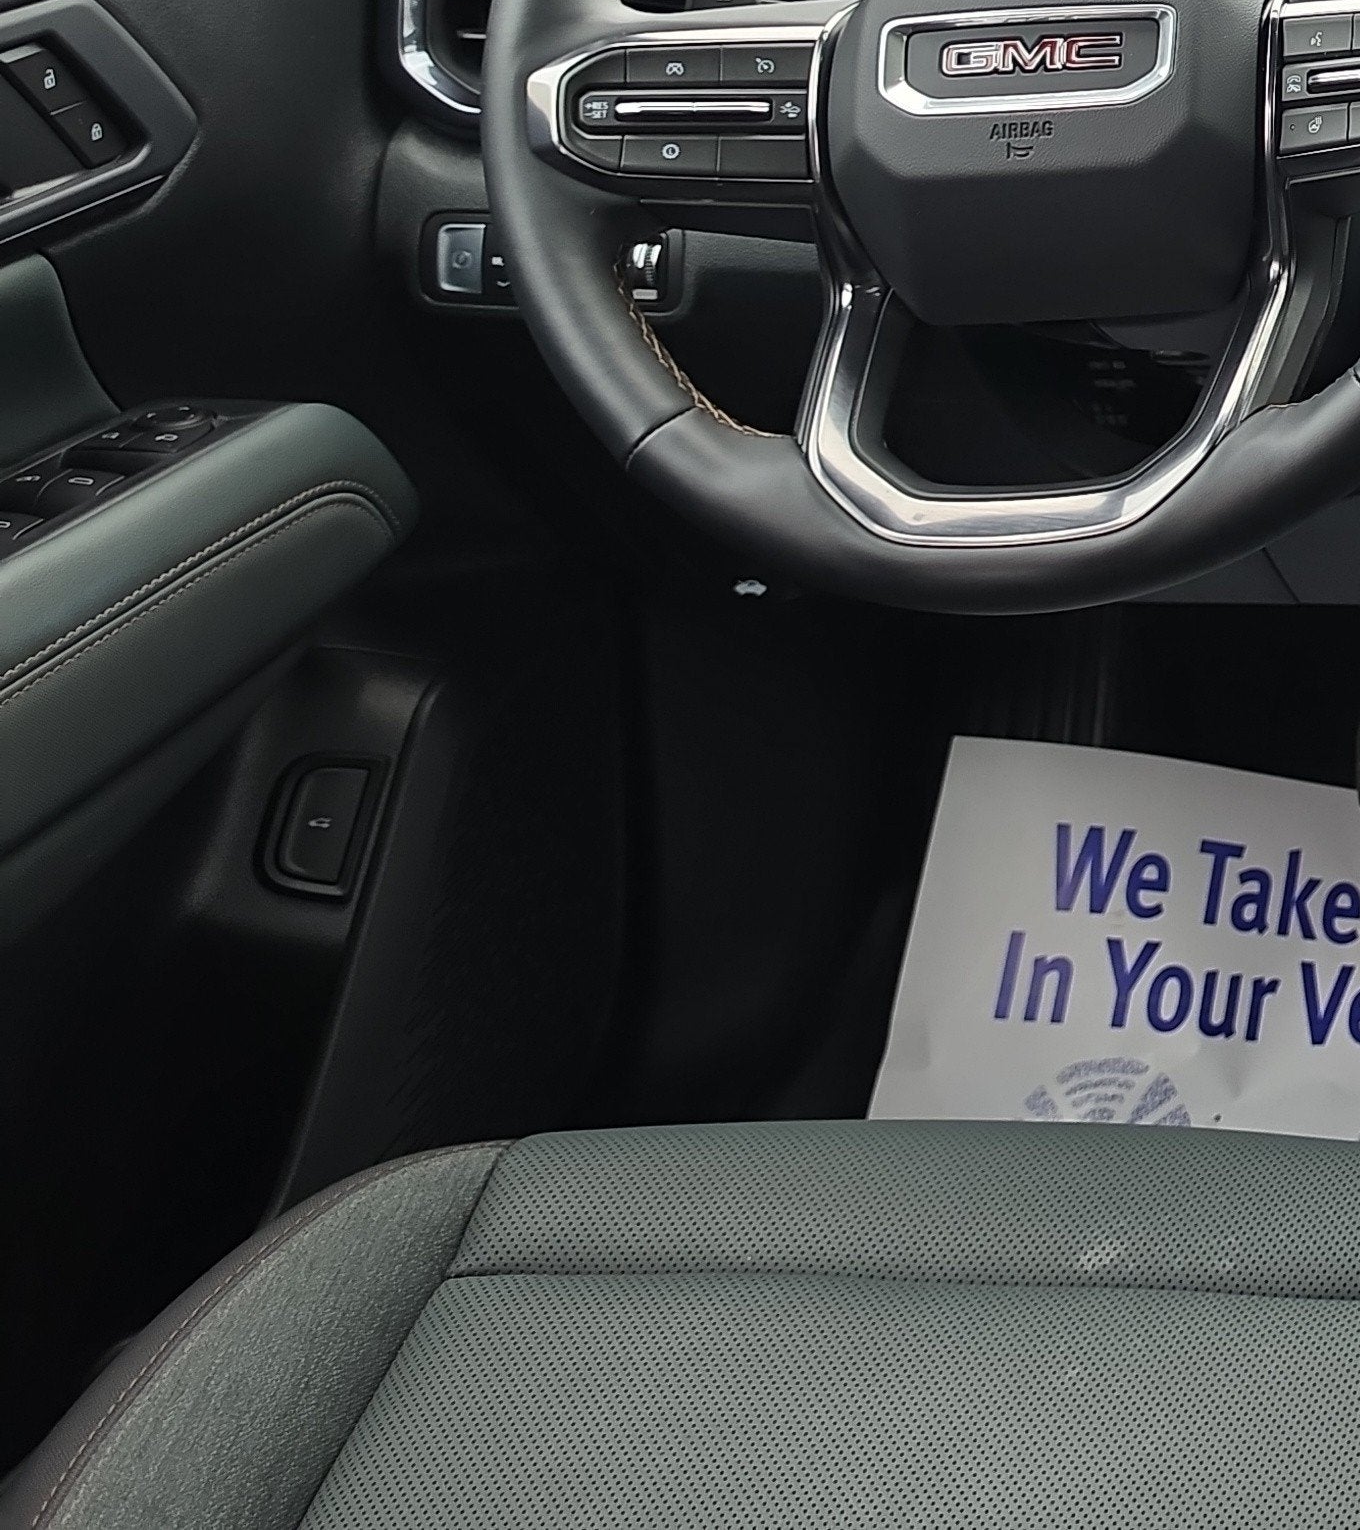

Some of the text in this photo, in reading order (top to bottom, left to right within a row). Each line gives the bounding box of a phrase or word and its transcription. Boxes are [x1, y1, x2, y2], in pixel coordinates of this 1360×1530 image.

[942, 35, 1121, 76] GMC
[989, 121, 1054, 139] AIRBAG
[1054, 823, 1170, 920] We
[994, 930, 1075, 1026] In
[1105, 936, 1282, 1044] Your
